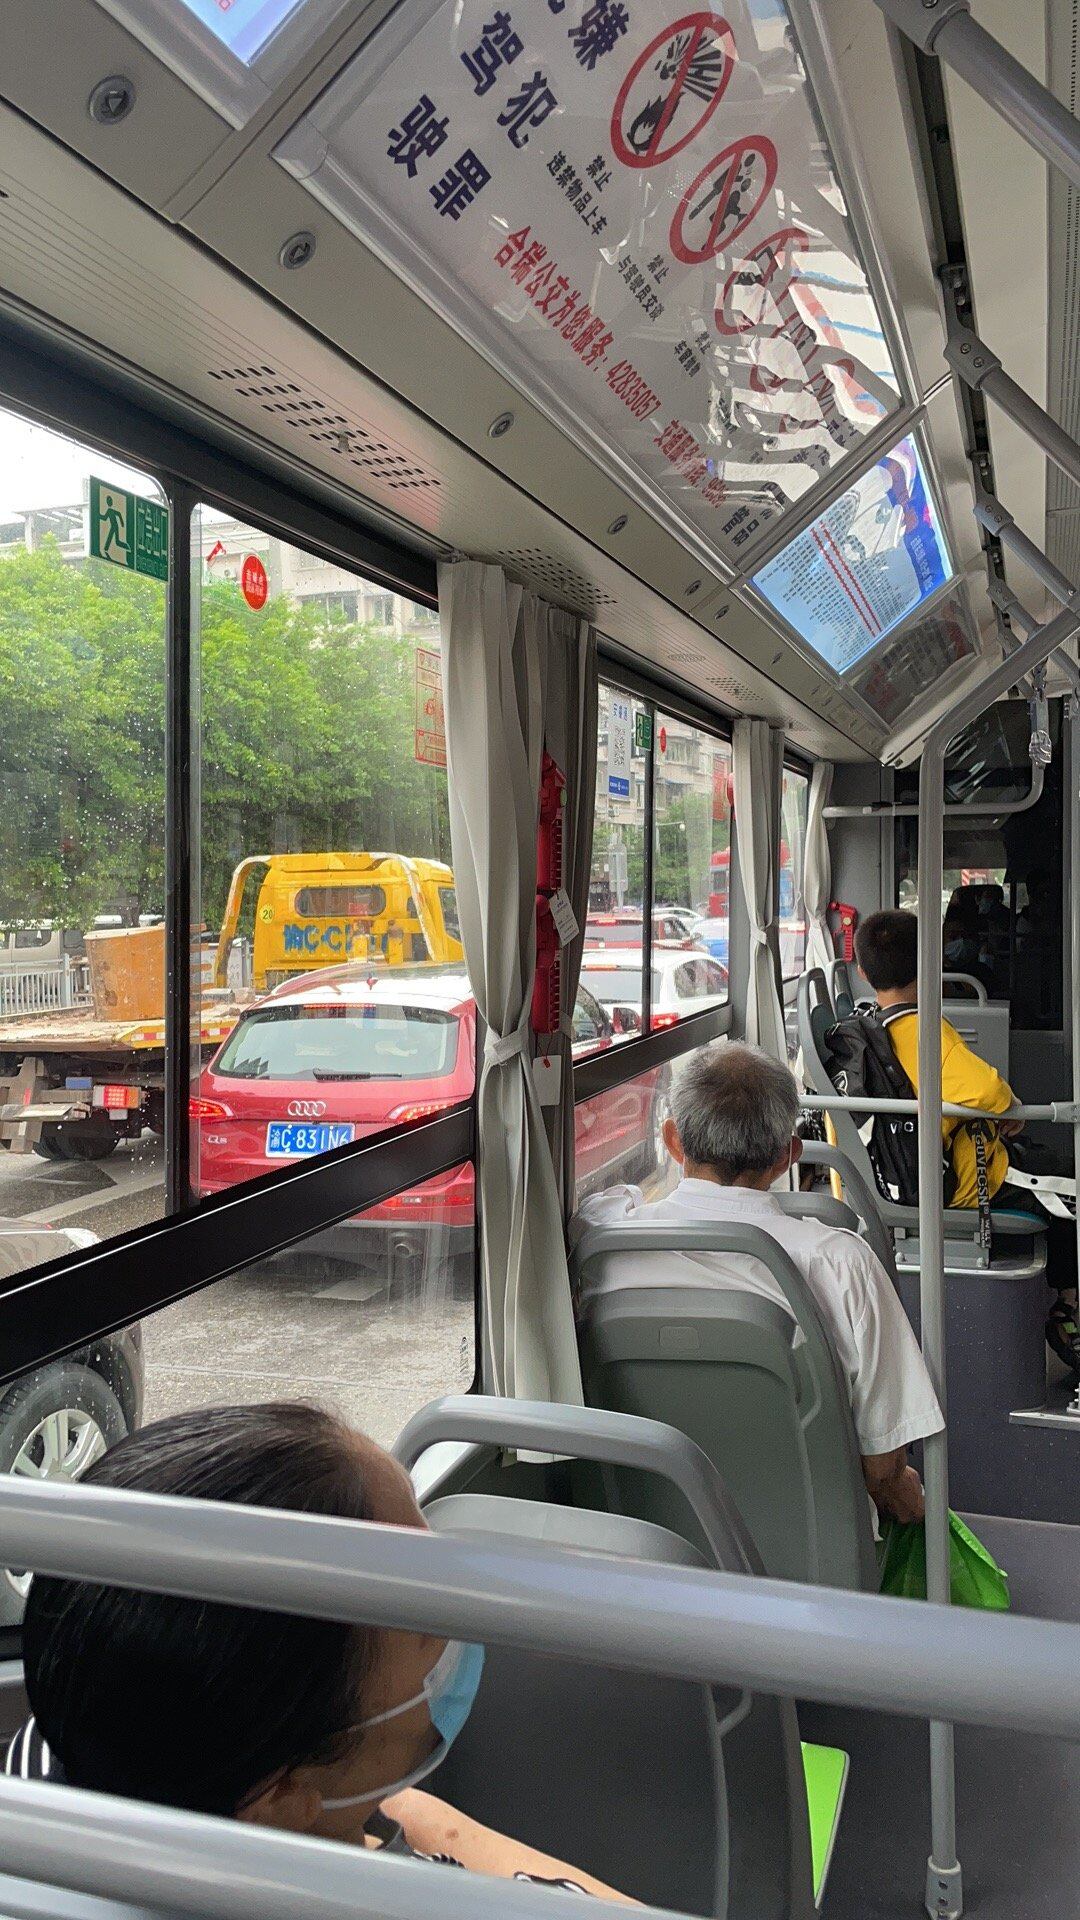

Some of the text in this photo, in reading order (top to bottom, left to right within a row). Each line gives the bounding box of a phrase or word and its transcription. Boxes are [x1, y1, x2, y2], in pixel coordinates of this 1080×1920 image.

[546, 150, 609, 236] 违禁物品上车
[584, 154, 613, 193] 禁止
[617, 254, 665, 322] 与驾驶员交谈
[647, 254, 670, 285] 禁止
